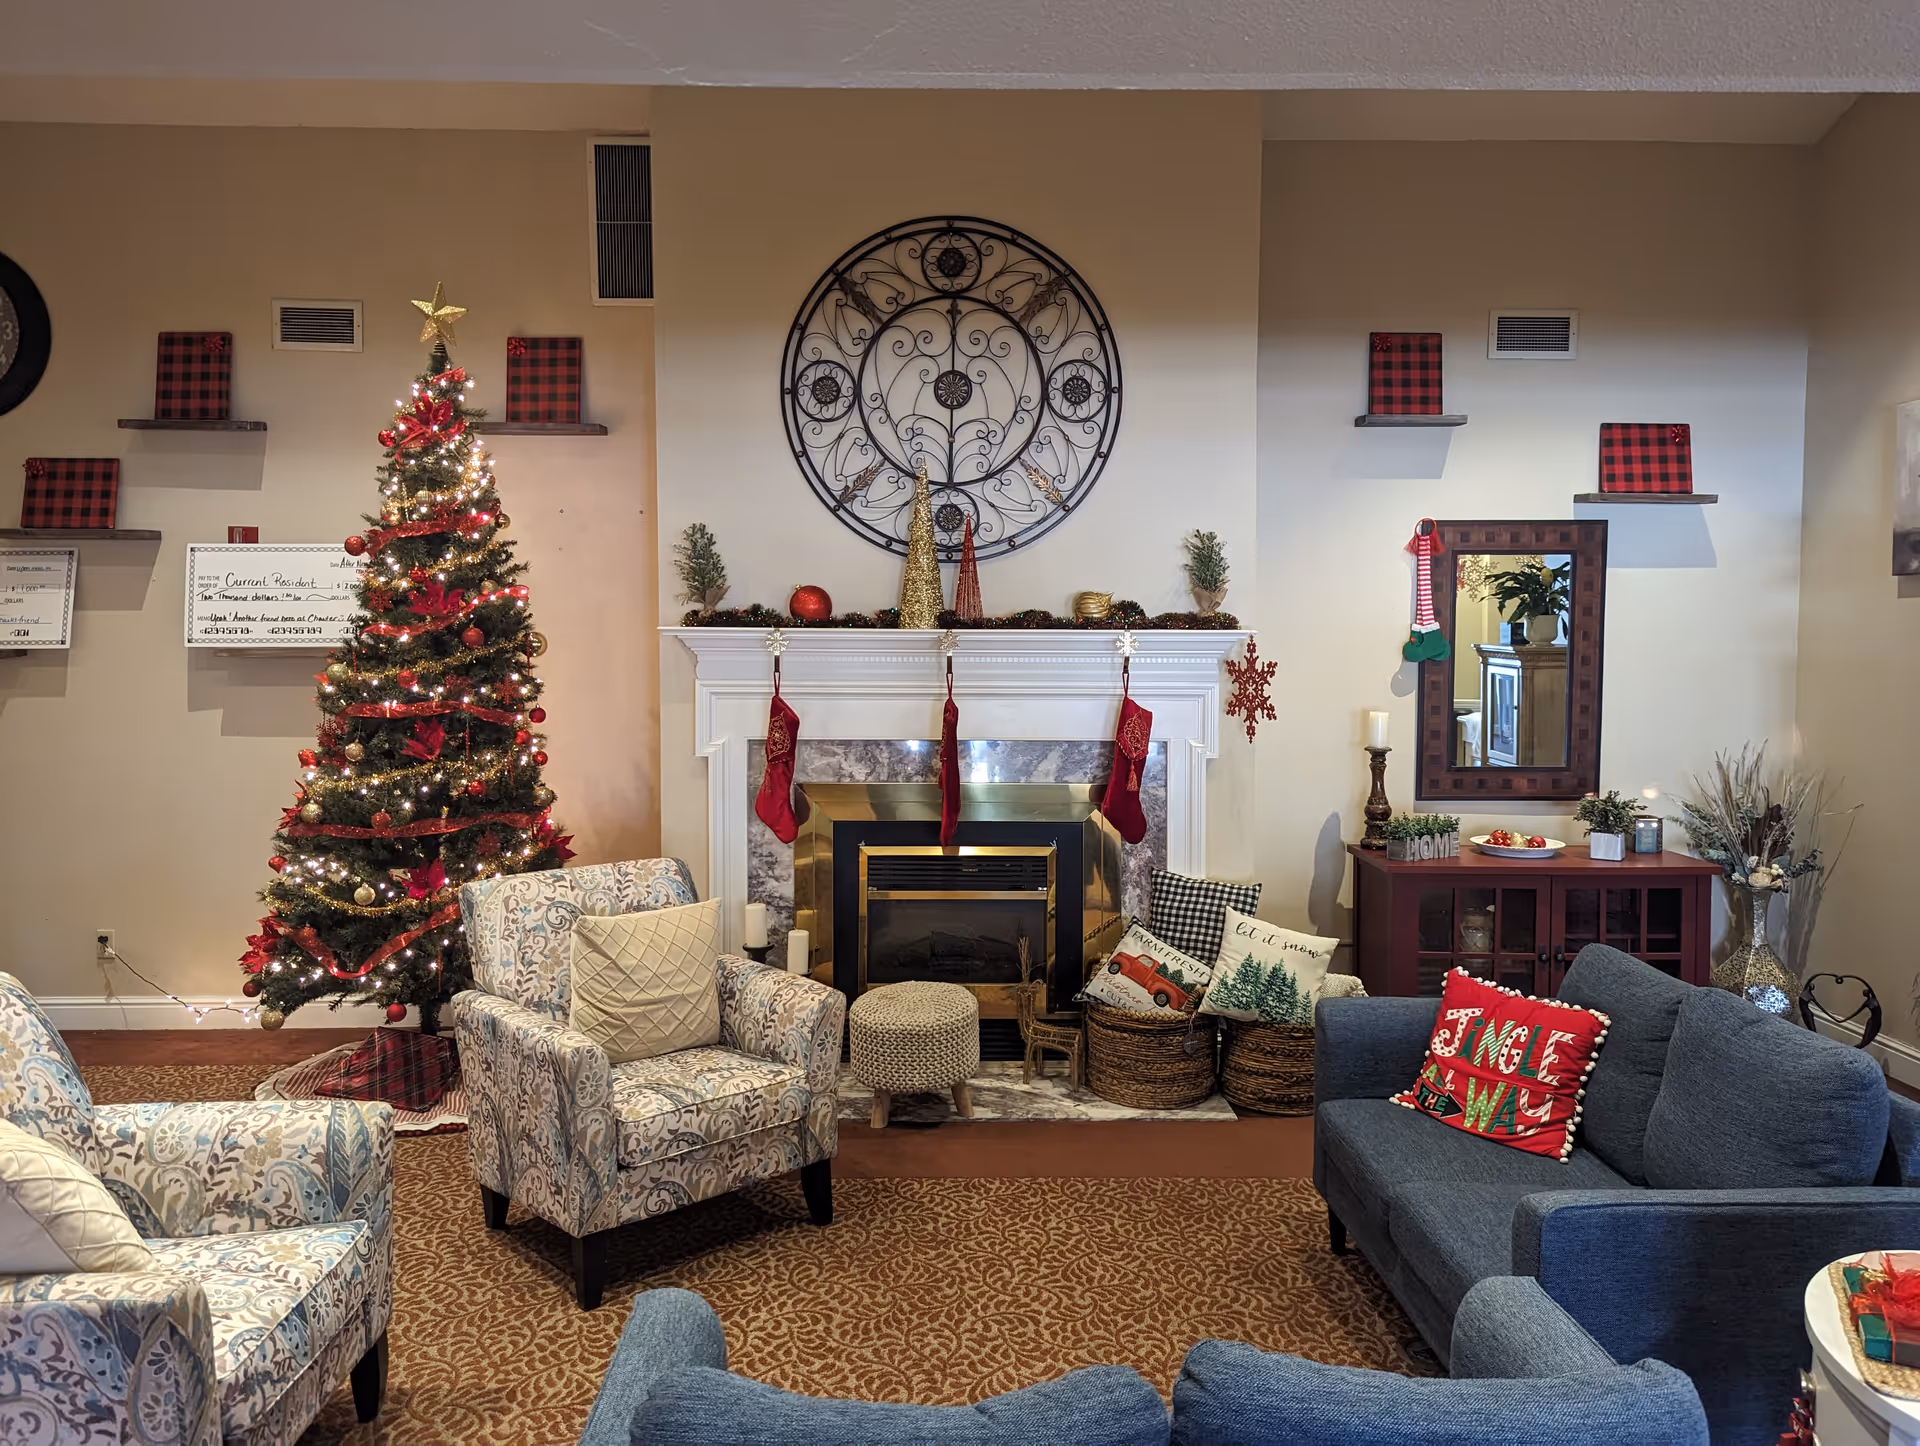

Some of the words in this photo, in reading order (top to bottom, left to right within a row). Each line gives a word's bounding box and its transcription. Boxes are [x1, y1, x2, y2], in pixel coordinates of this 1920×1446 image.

[3, 321, 13, 340] 3
[225, 572, 269, 587] Current
[271, 572, 318, 589] Resident
[232, 611, 258, 622] Another
[1405, 831, 1460, 862] HOME
[1235, 921, 1261, 940] let
[1262, 932, 1281, 946] it
[1281, 941, 1322, 959] snow
[1131, 930, 1165, 954] FARM
[1164, 951, 1206, 978] FRESH
[1106, 990, 1121, 1005] CUT
[1421, 1064, 1456, 1091] ALL
[1413, 1086, 1450, 1113] THE
[1462, 1076, 1555, 1137] WAY
